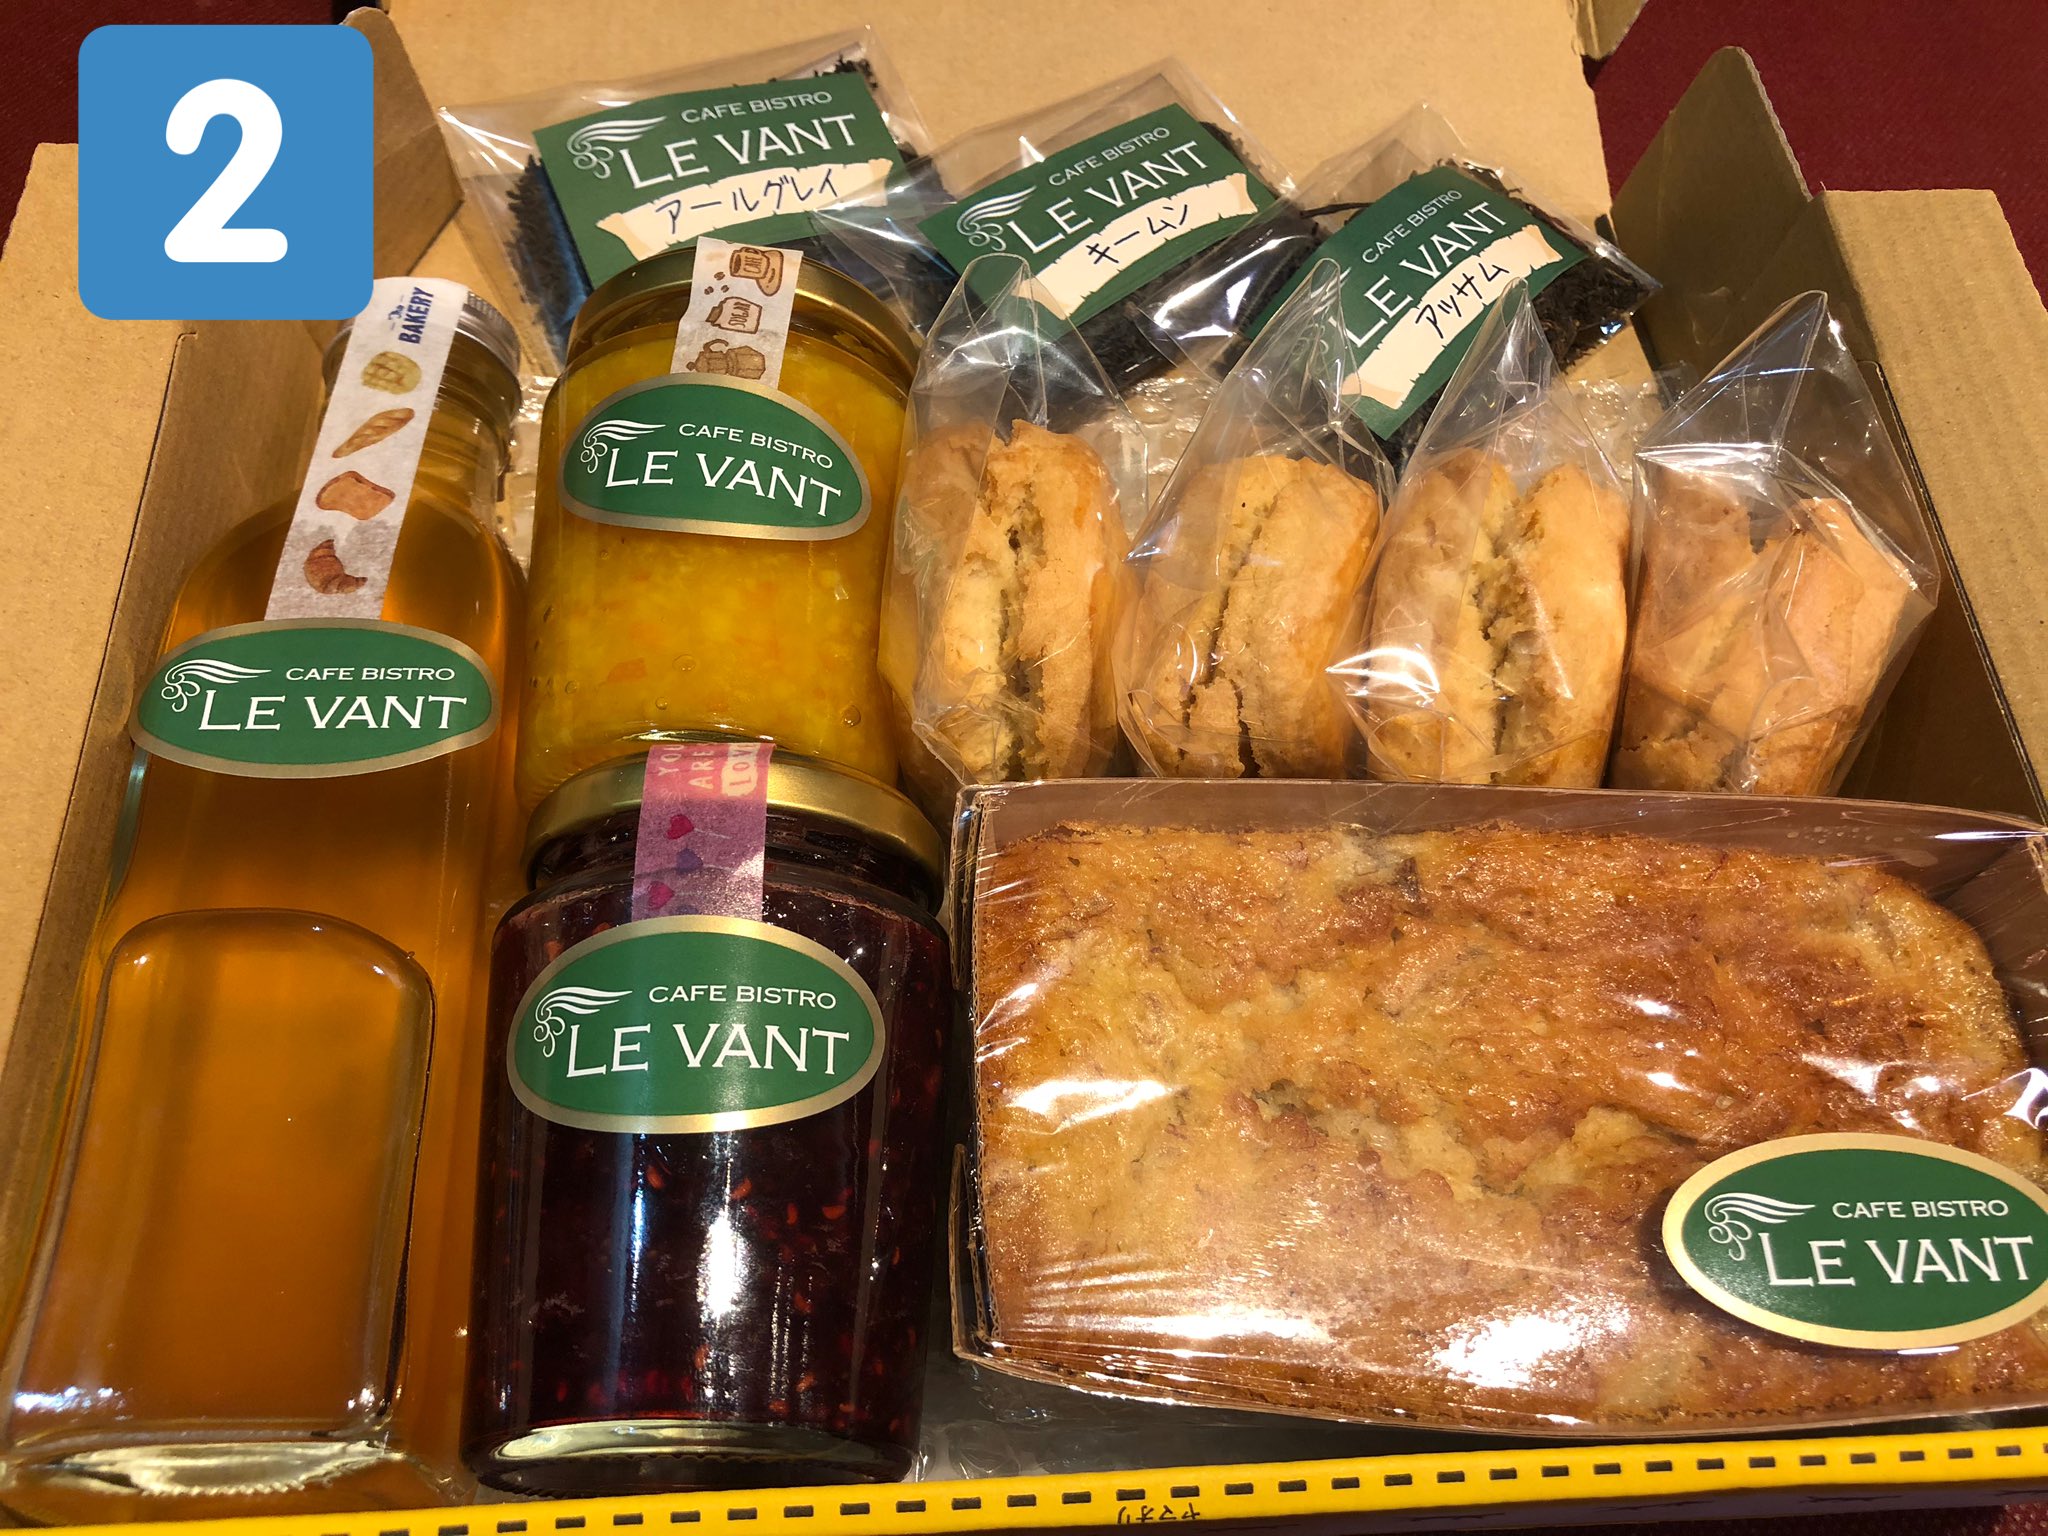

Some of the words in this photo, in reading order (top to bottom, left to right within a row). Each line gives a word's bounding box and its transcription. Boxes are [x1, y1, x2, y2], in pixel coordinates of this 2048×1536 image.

[681, 103, 746, 123] CAFE
[750, 91, 832, 114] BISTRO
[620, 138, 710, 189] LE
[713, 113, 856, 165] VANT
[1048, 156, 1102, 186] CAFE
[1101, 127, 1170, 161] BISTRO
[656, 168, 838, 234] アールグレイ
[1007, 197, 1093, 253] LE
[1084, 140, 1208, 208] VANT
[1085, 204, 1188, 264] キームン
[1362, 223, 1411, 263] CAFE
[1406, 189, 1463, 228] BISTRO
[743, 254, 763, 274] CAFE
[1328, 275, 1414, 348] LE
[1400, 201, 1508, 280] VANT
[398, 287, 435, 344] BAKERY
[727, 301, 752, 329] SUGAR
[679, 423, 744, 443] CAFE
[750, 433, 833, 469] BISTRO
[605, 448, 679, 488] LE
[695, 452, 842, 517] VANT
[285, 667, 355, 681] CAFE
[361, 667, 455, 681] BISTRO
[199, 689, 286, 731] LE
[304, 695, 467, 729] VANT
[657, 743, 685, 776] YOU
[688, 750, 715, 790] ARE
[648, 985, 727, 1003] CAFE
[736, 985, 837, 1010] BISTRO
[566, 1023, 651, 1078] LE
[672, 1023, 850, 1075] VANT
[1832, 1202, 1905, 1219] CAFE
[1914, 1199, 2009, 1218] BISTRO
[1758, 1232, 1856, 1287] LE
[1865, 1235, 2034, 1285] VANT
[1117, 1502, 1200, 1524] ヤマオリ
